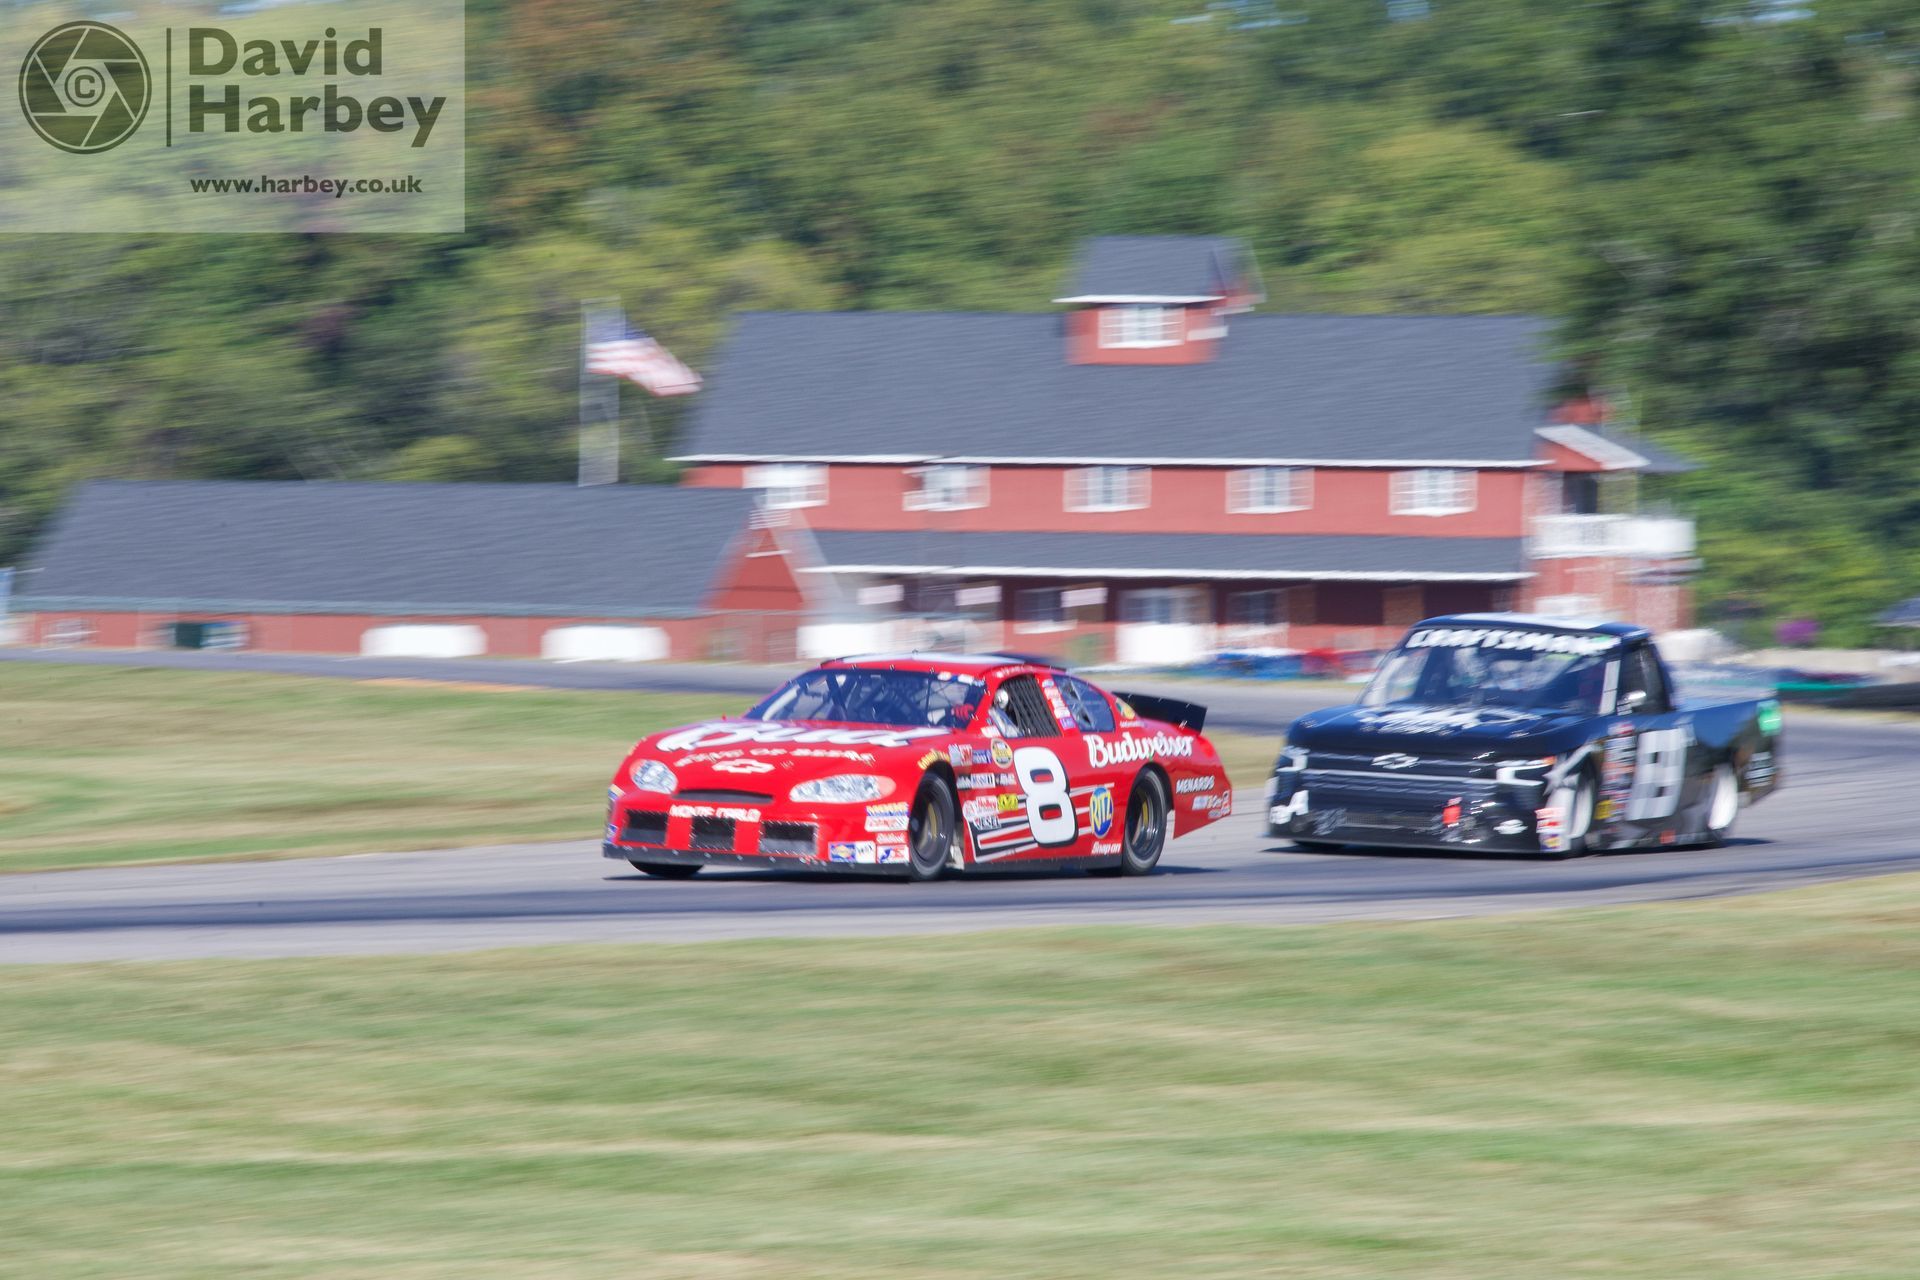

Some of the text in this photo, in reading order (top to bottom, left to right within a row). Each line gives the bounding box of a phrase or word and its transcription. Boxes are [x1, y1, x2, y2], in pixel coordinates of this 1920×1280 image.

[1405, 629, 1621, 656] CRAFTSMAN
[1083, 731, 1194, 768] Budweiser
[1013, 746, 1078, 847] 8
[1176, 775, 1215, 794] MENARDS
[1090, 791, 1112, 833] RITZ
